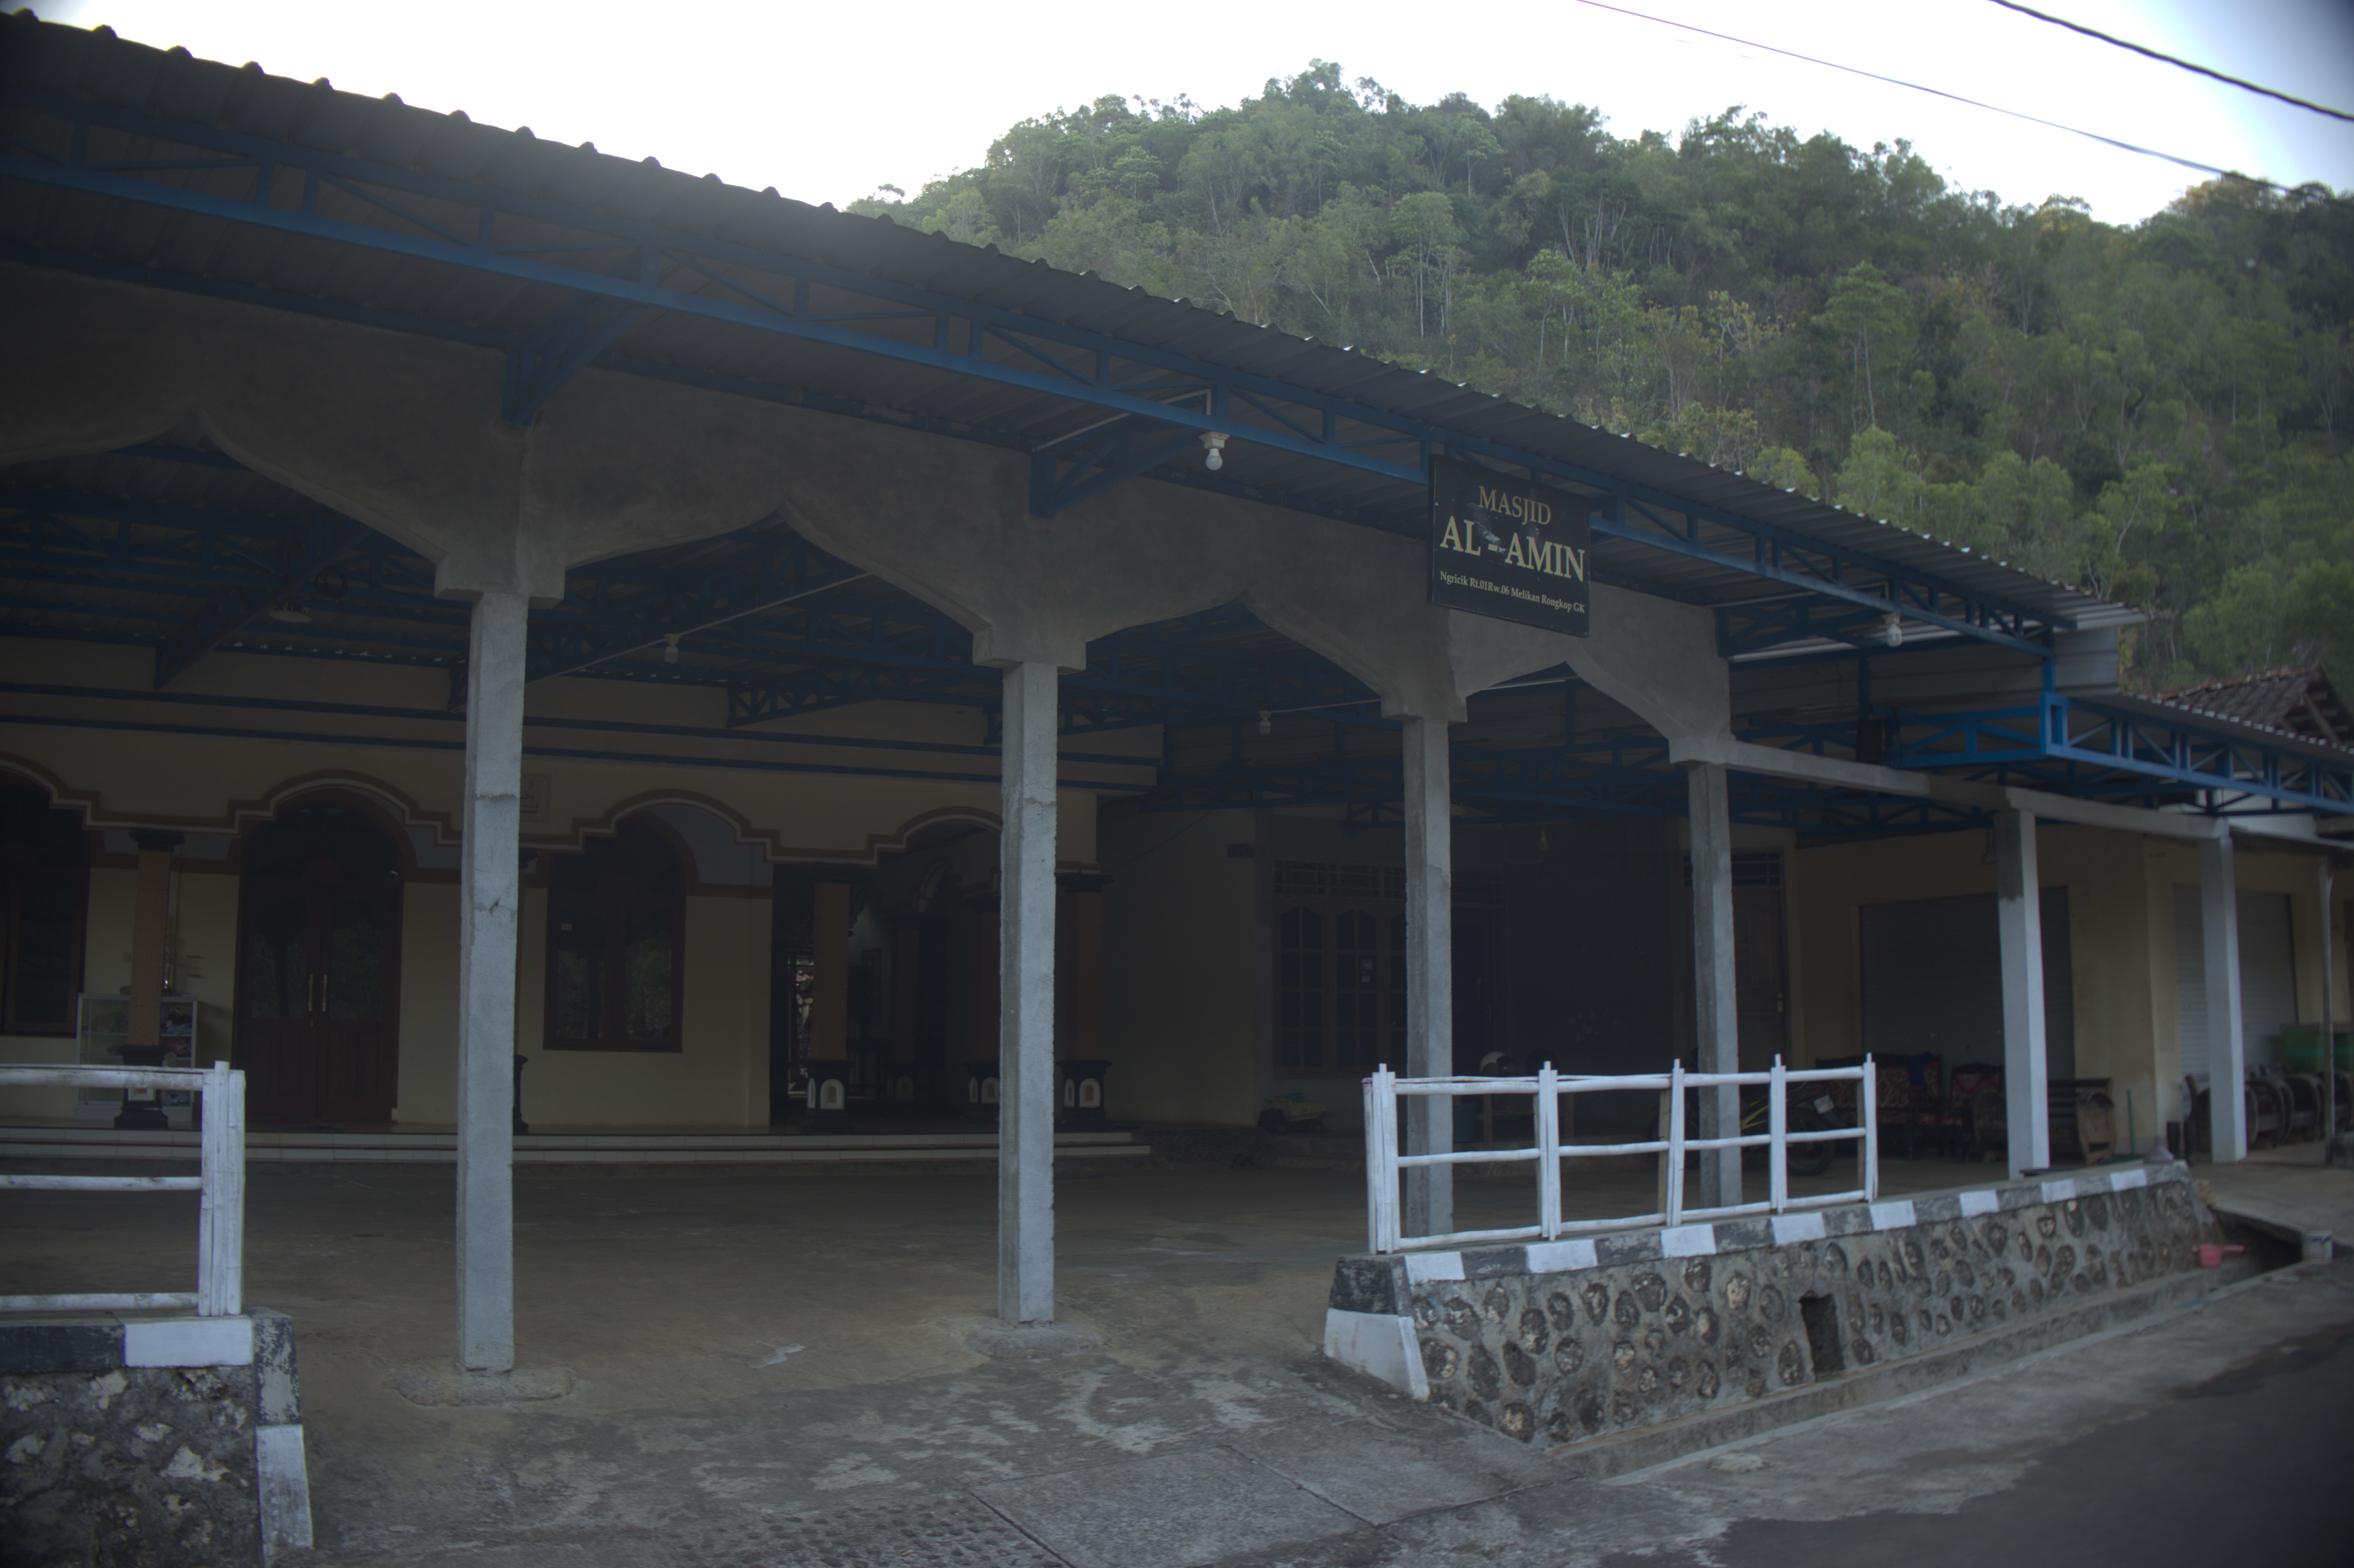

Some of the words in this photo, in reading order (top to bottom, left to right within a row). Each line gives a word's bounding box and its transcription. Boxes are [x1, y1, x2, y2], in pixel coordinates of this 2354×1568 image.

[1479, 486, 1551, 525] MASJID
[1440, 516, 1481, 556] AL
[1505, 532, 1585, 582] AMIN
[1440, 571, 1468, 585] Ngricik
[1511, 588, 1540, 602] Melikan
[1542, 594, 1572, 612] Rongkop
[1573, 602, 1585, 614] GK
